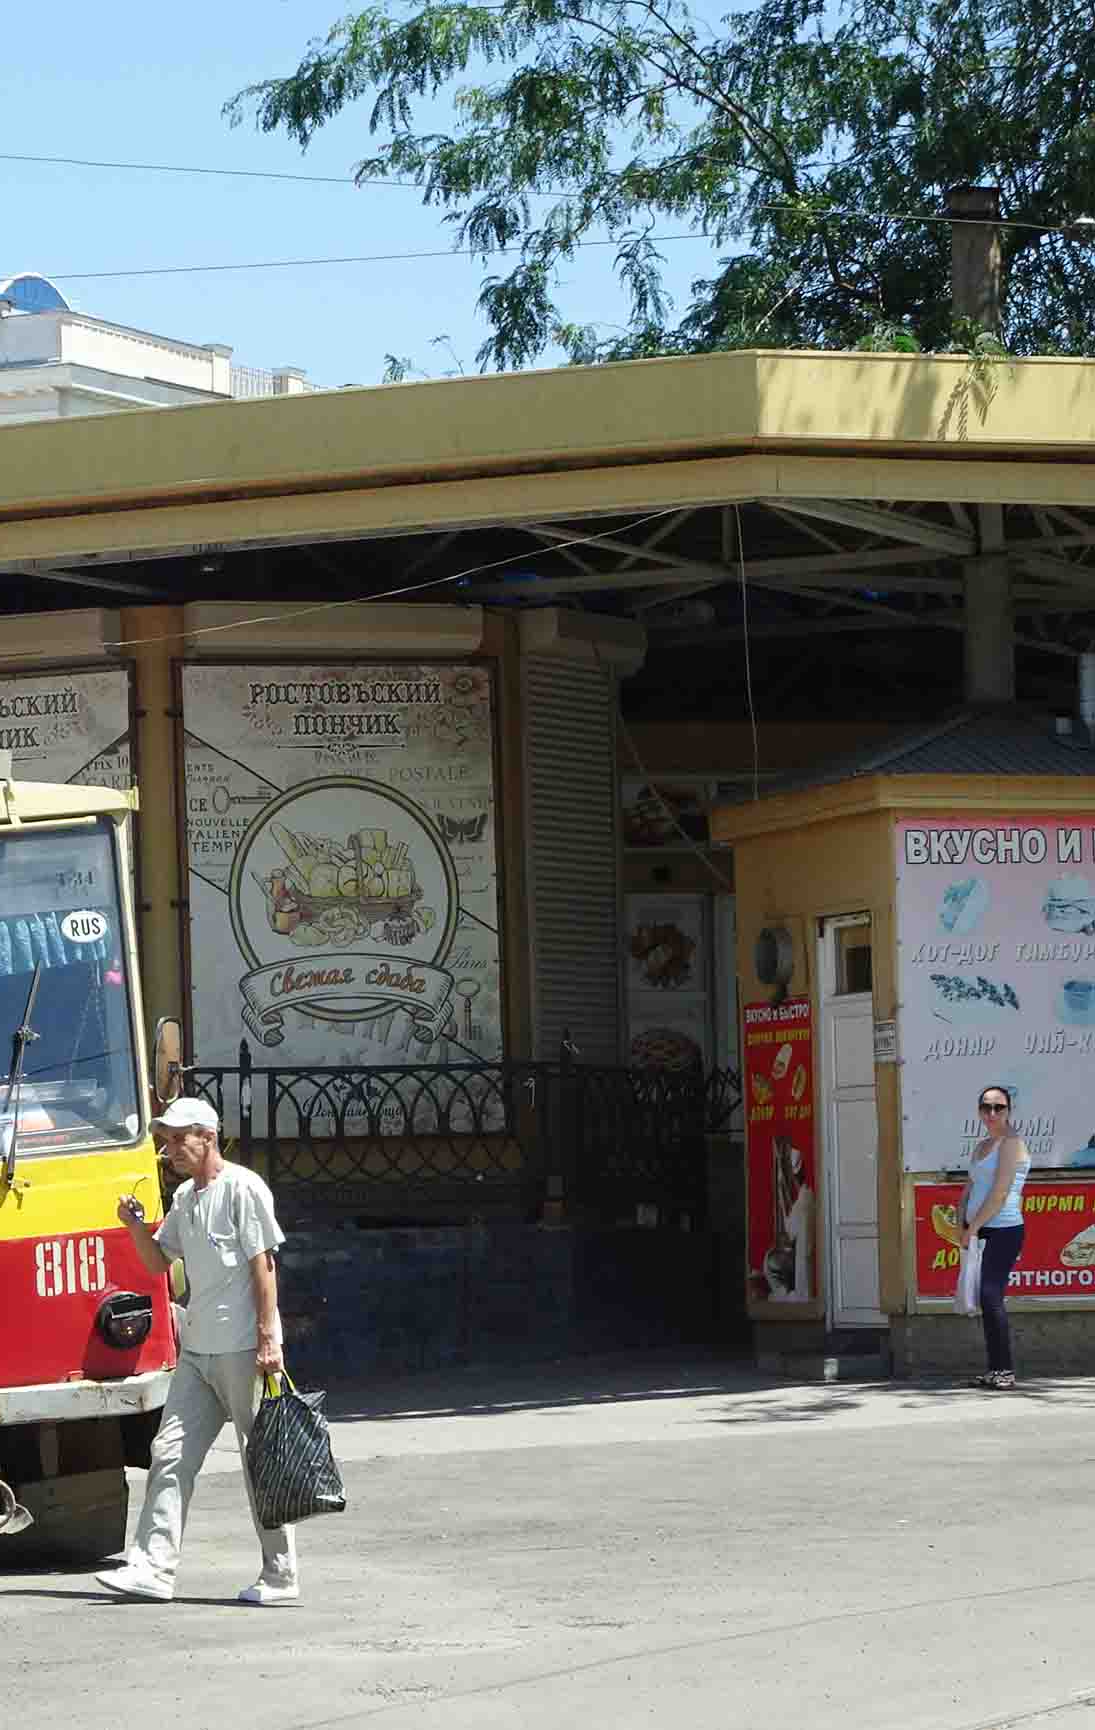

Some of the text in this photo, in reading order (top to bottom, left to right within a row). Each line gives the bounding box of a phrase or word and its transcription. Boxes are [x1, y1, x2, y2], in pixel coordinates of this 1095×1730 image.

[293, 713, 401, 736] ПОНЧИК
[905, 828, 1048, 864] ВКУСНО
[1056, 828, 1082, 864] И
[70, 917, 101, 937] RUS
[35, 1236, 106, 1297] 818
[1008, 1270, 1094, 1287] ЯТНОГО
